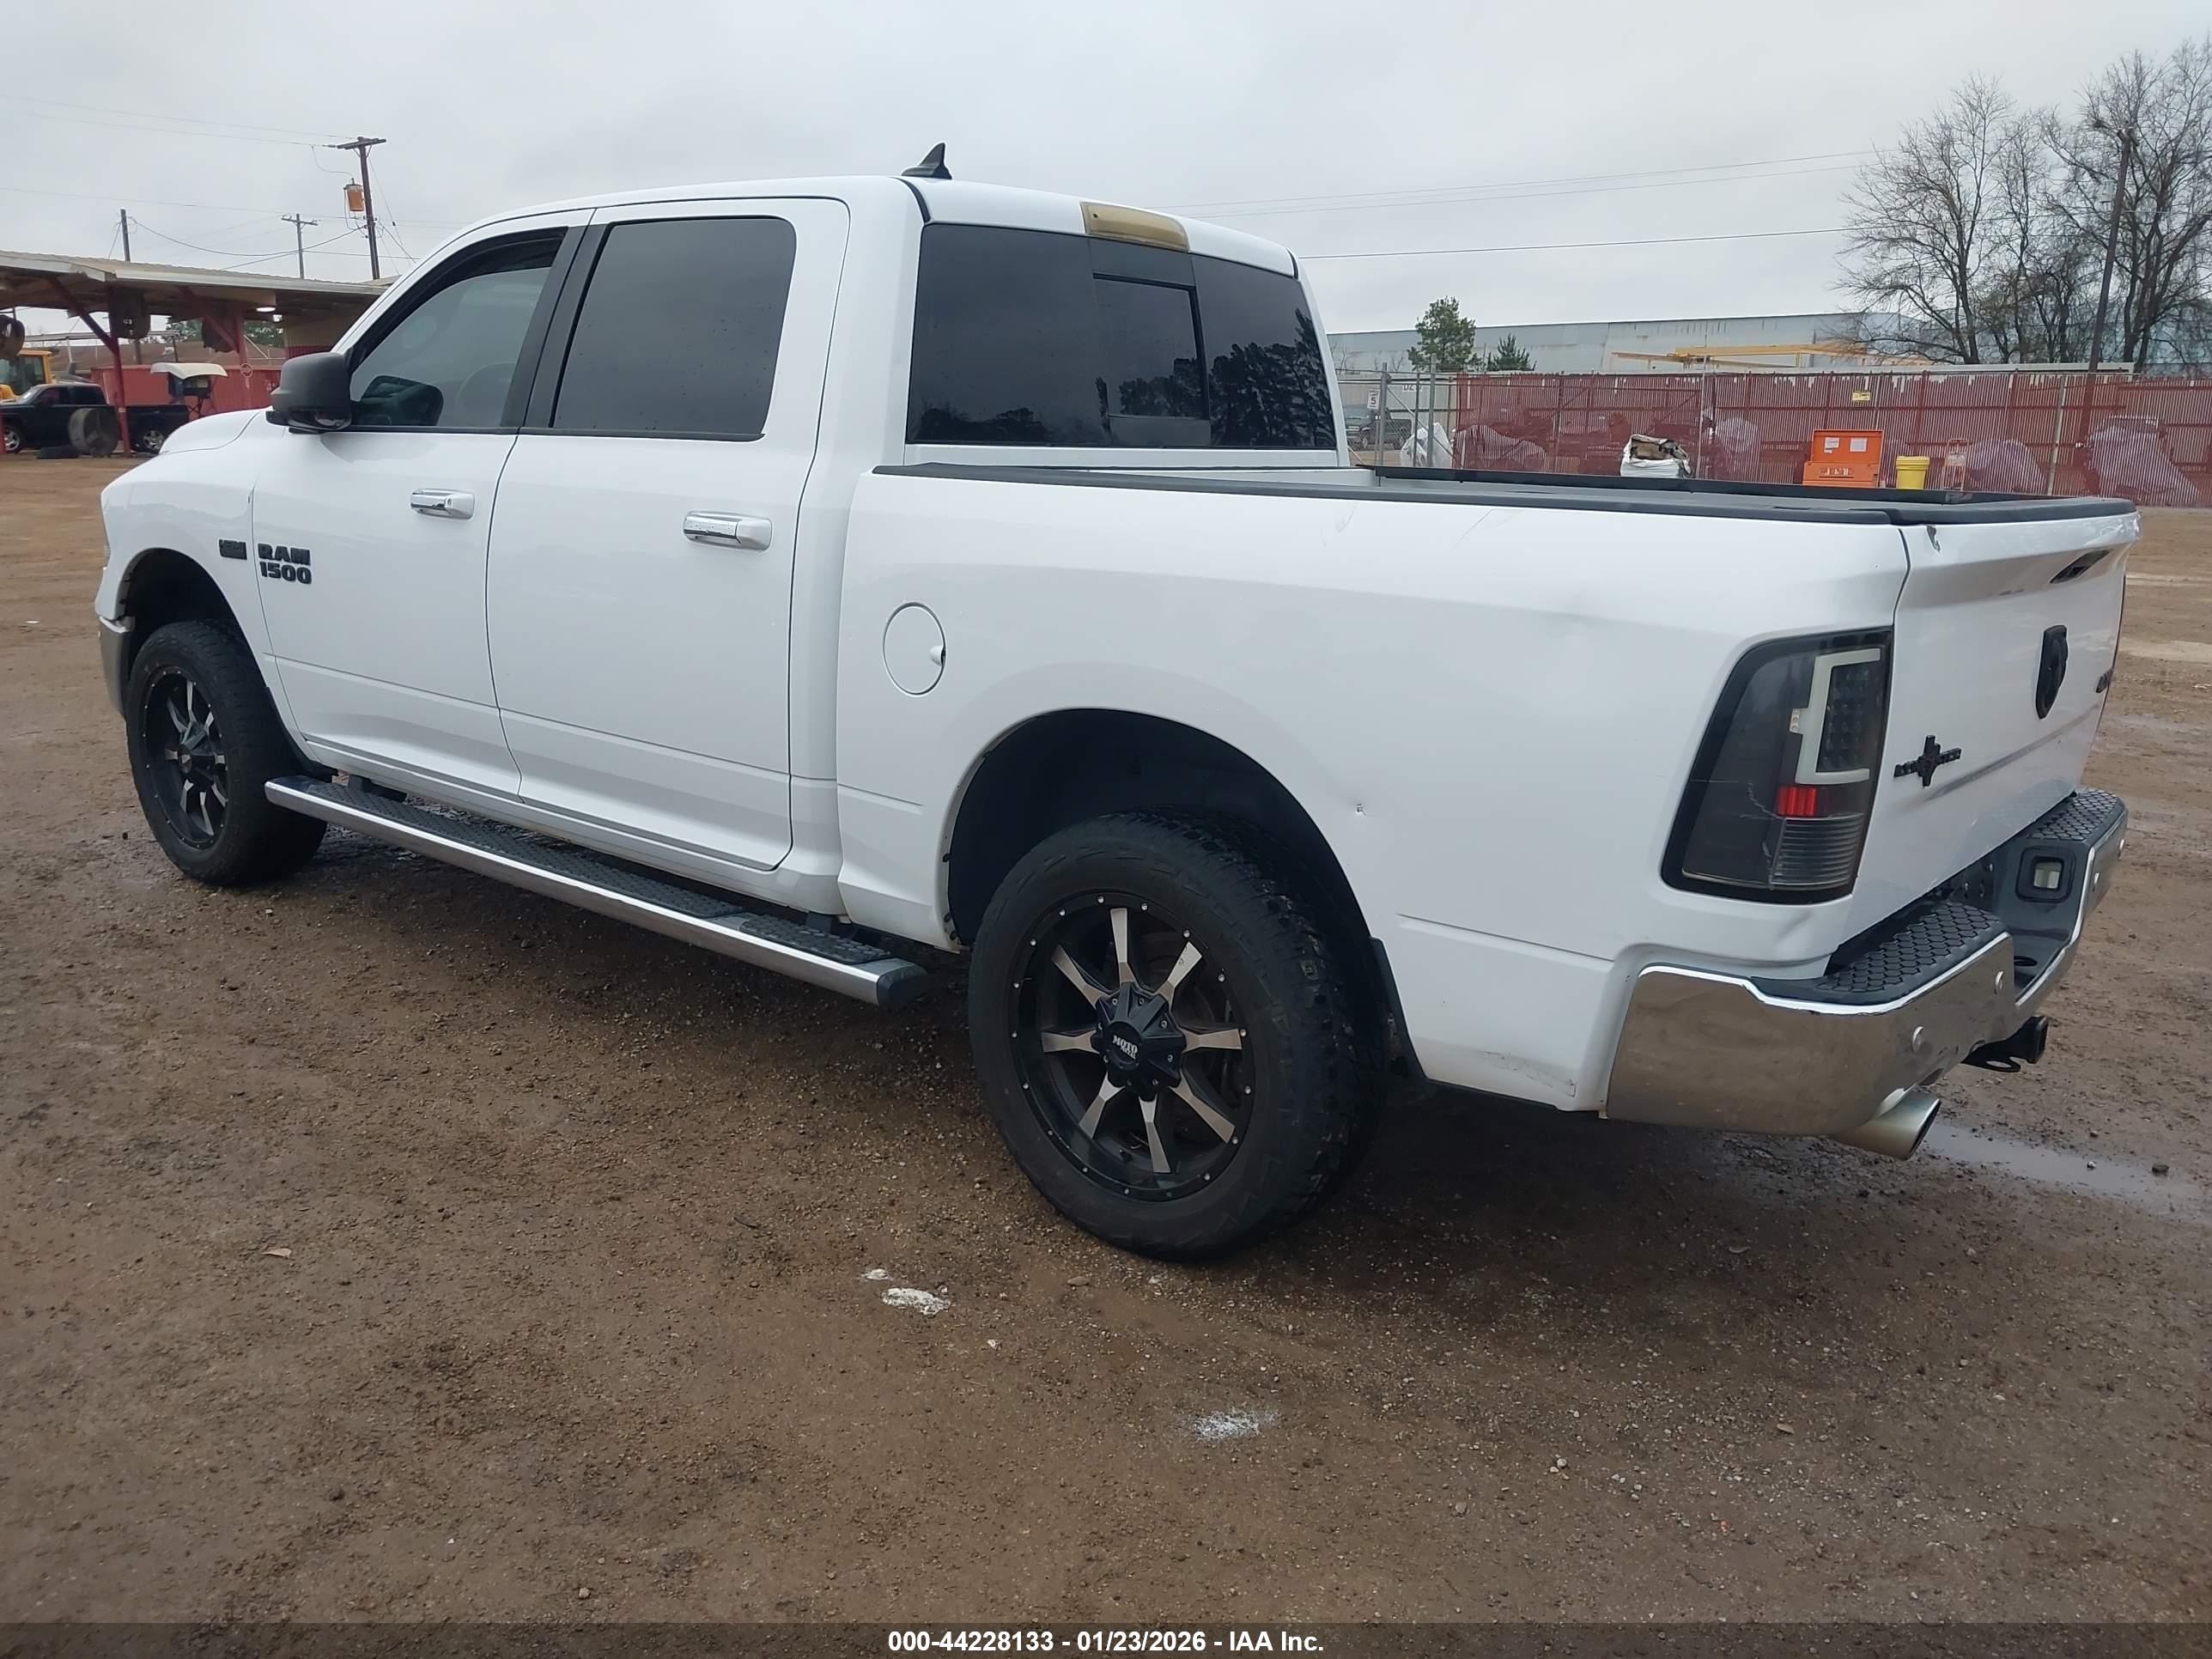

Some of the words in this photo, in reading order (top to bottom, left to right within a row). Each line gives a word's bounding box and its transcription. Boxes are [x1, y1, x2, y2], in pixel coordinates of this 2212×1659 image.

[258, 543, 311, 566] RAM
[259, 561, 313, 584] 1500
[1112, 1034, 1138, 1054] MOTO
